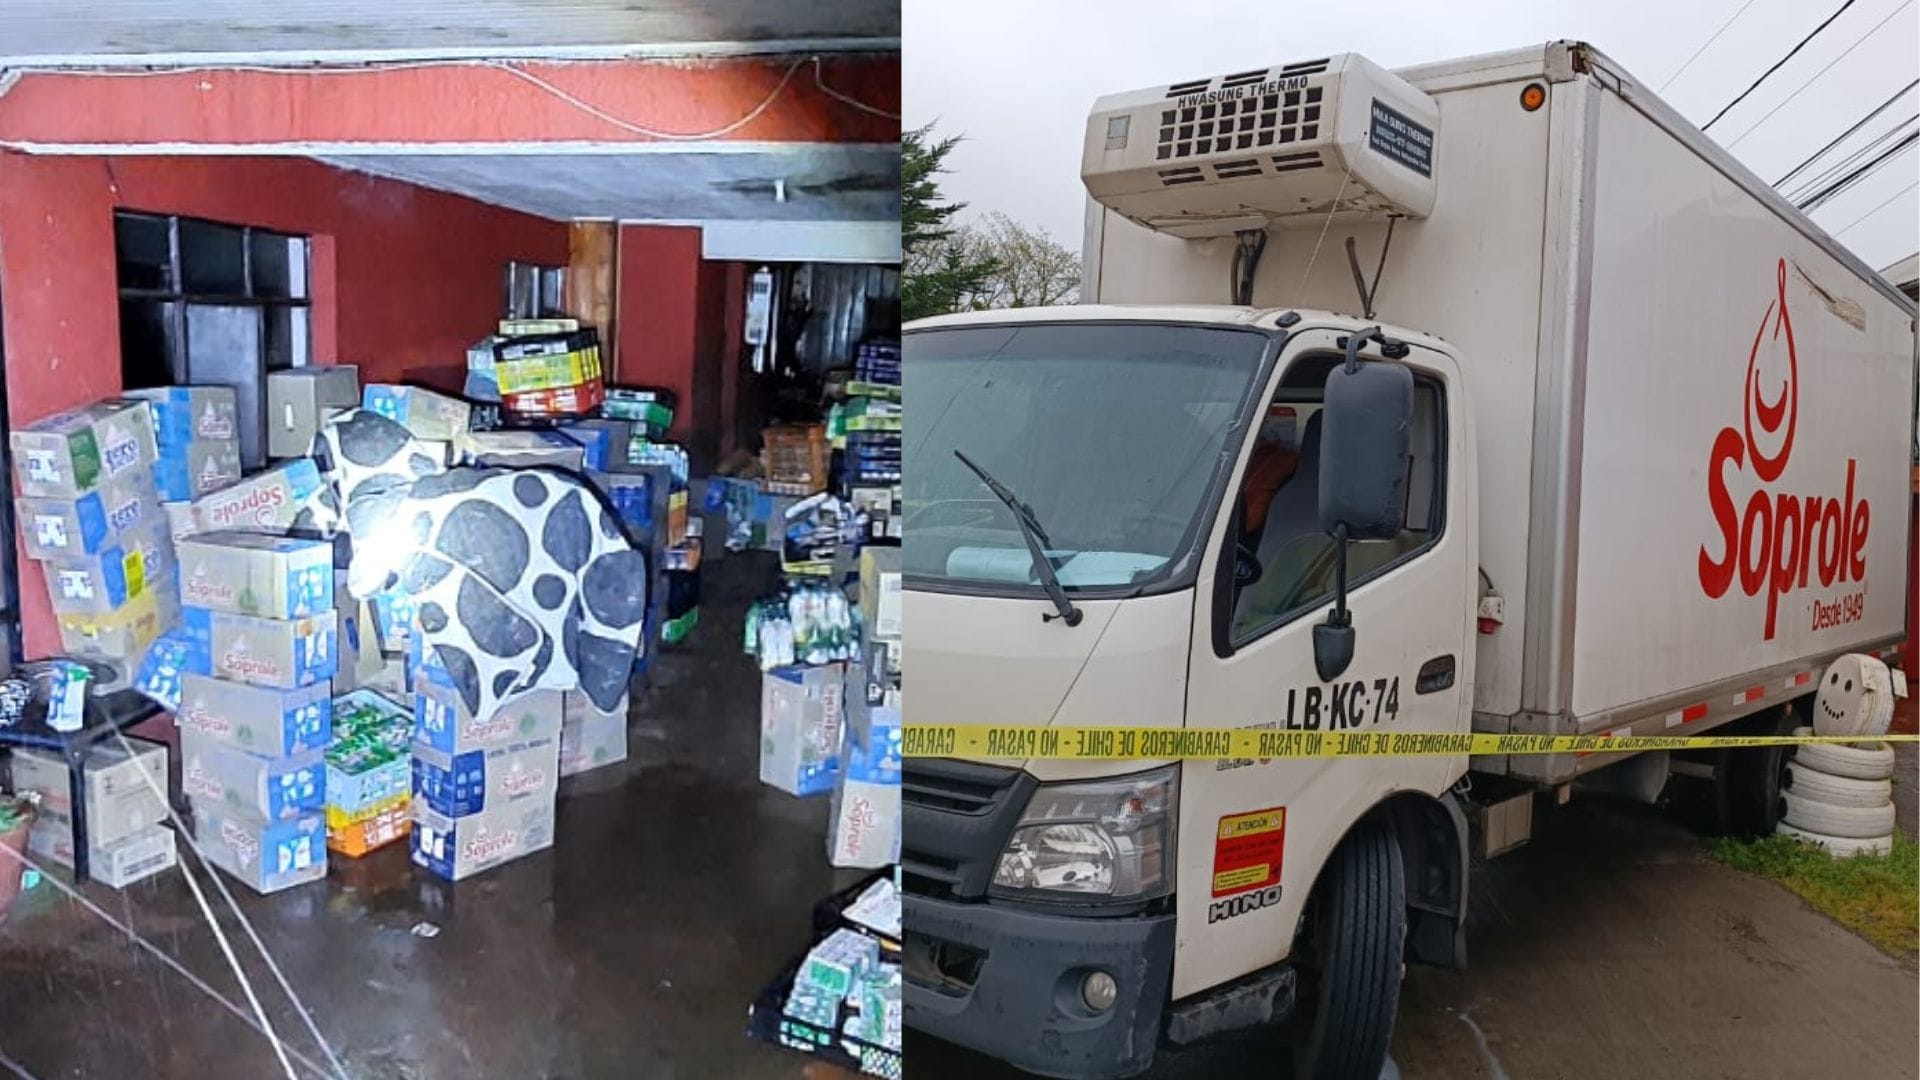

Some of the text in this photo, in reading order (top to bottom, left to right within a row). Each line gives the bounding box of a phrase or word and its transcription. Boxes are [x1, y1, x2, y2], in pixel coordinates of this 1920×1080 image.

[1178, 76, 1309, 108] HWASUNG THERMO
[212, 485, 283, 522] Soprole
[1698, 427, 1870, 640] Soprole
[1812, 593, 1864, 631] Desde 1949
[1208, 885, 1282, 924] HINO
